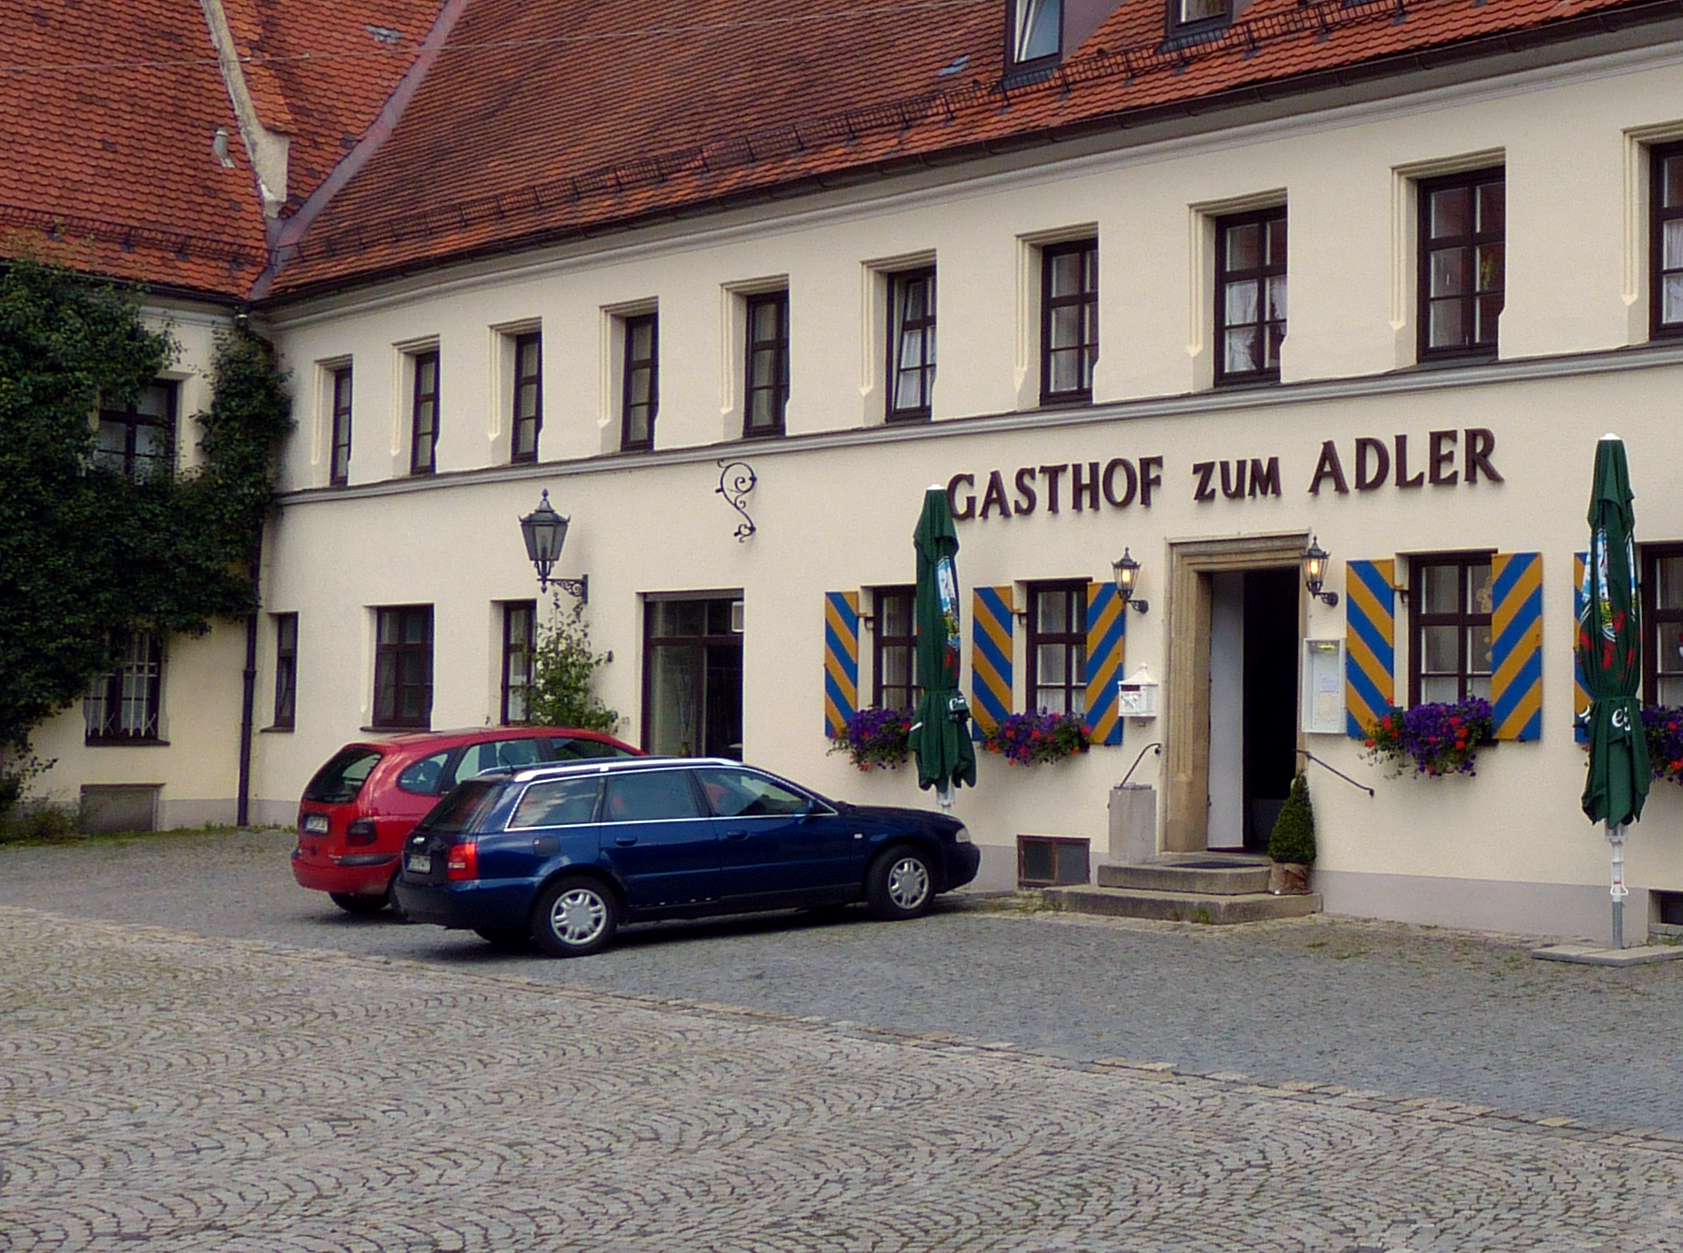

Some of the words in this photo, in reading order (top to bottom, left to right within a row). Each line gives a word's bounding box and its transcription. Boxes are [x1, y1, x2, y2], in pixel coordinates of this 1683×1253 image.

[947, 455, 1163, 520] GASTHOF
[1192, 456, 1282, 500] ZUM
[1307, 428, 1504, 494] ADLER
